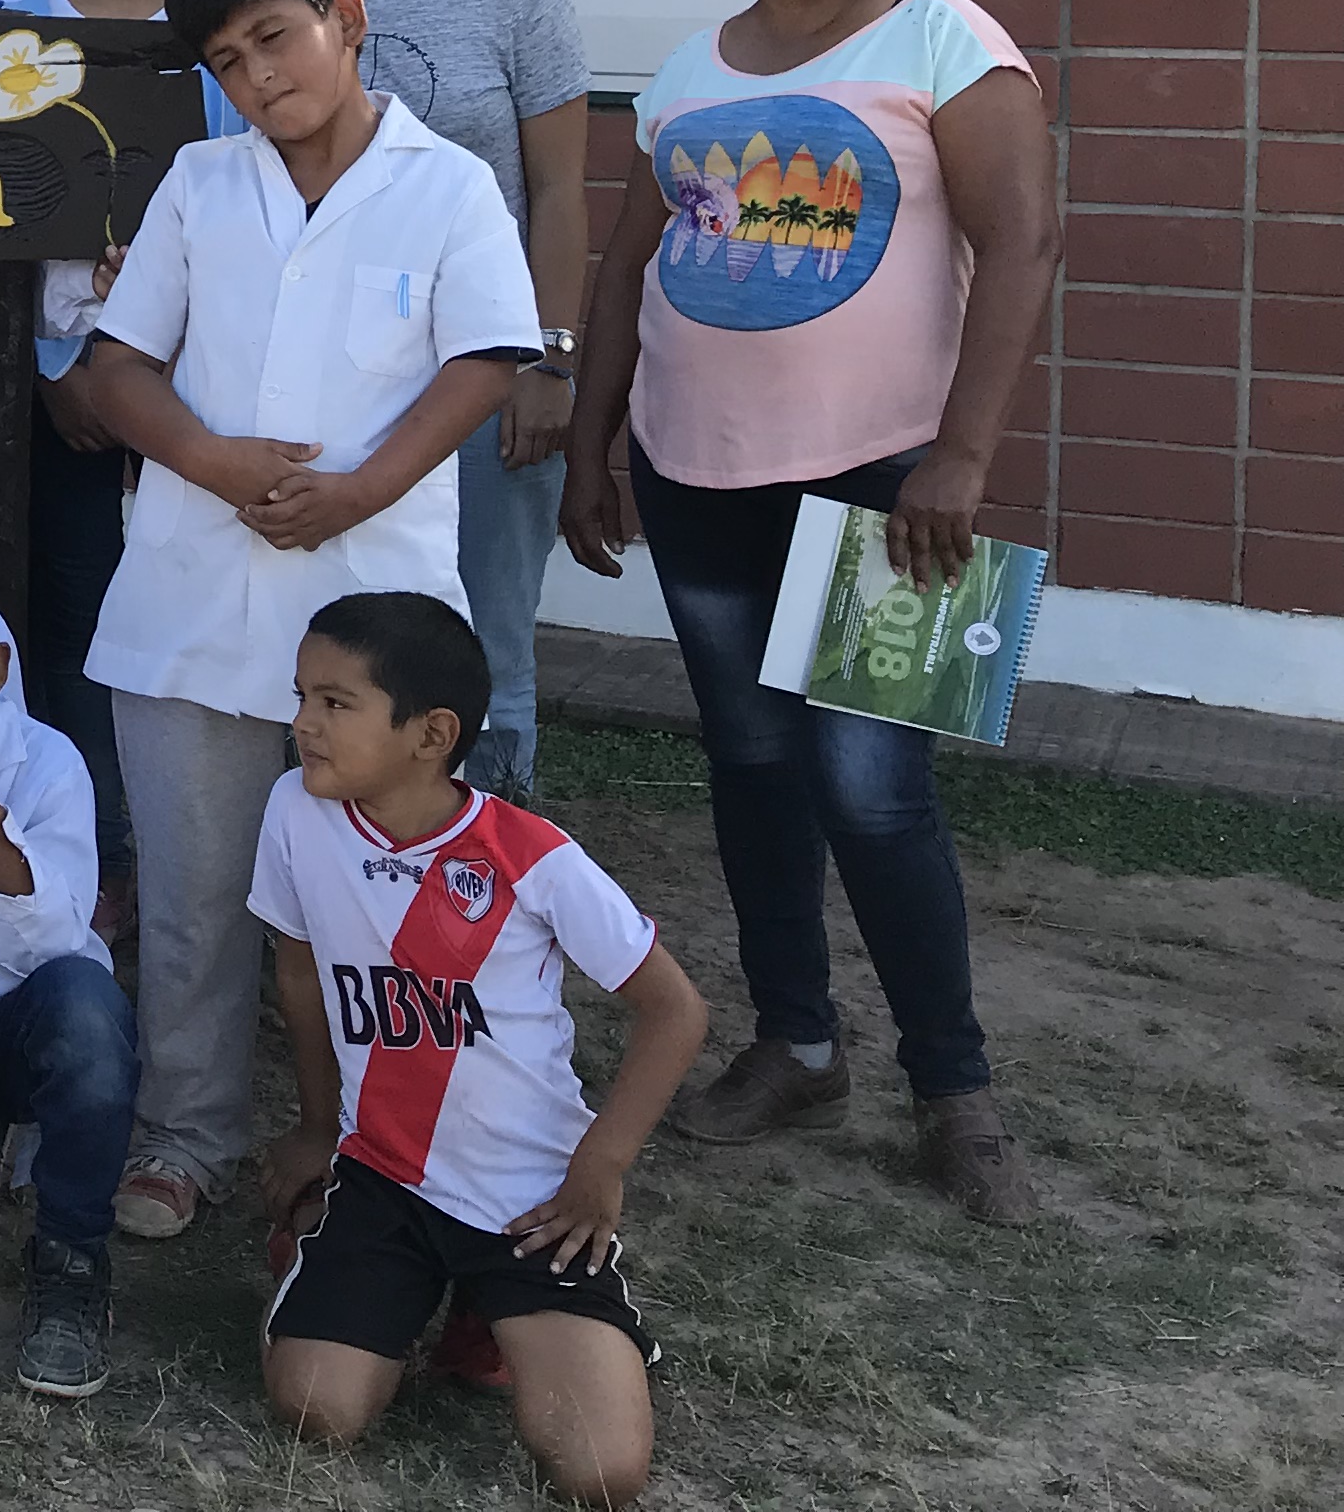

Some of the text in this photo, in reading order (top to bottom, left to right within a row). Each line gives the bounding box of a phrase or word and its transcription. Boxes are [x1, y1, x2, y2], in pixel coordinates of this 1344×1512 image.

[923, 596, 950, 674] IMPENETRABLE
[454, 870, 485, 899] RIVER
[331, 963, 494, 1049] BBVA
